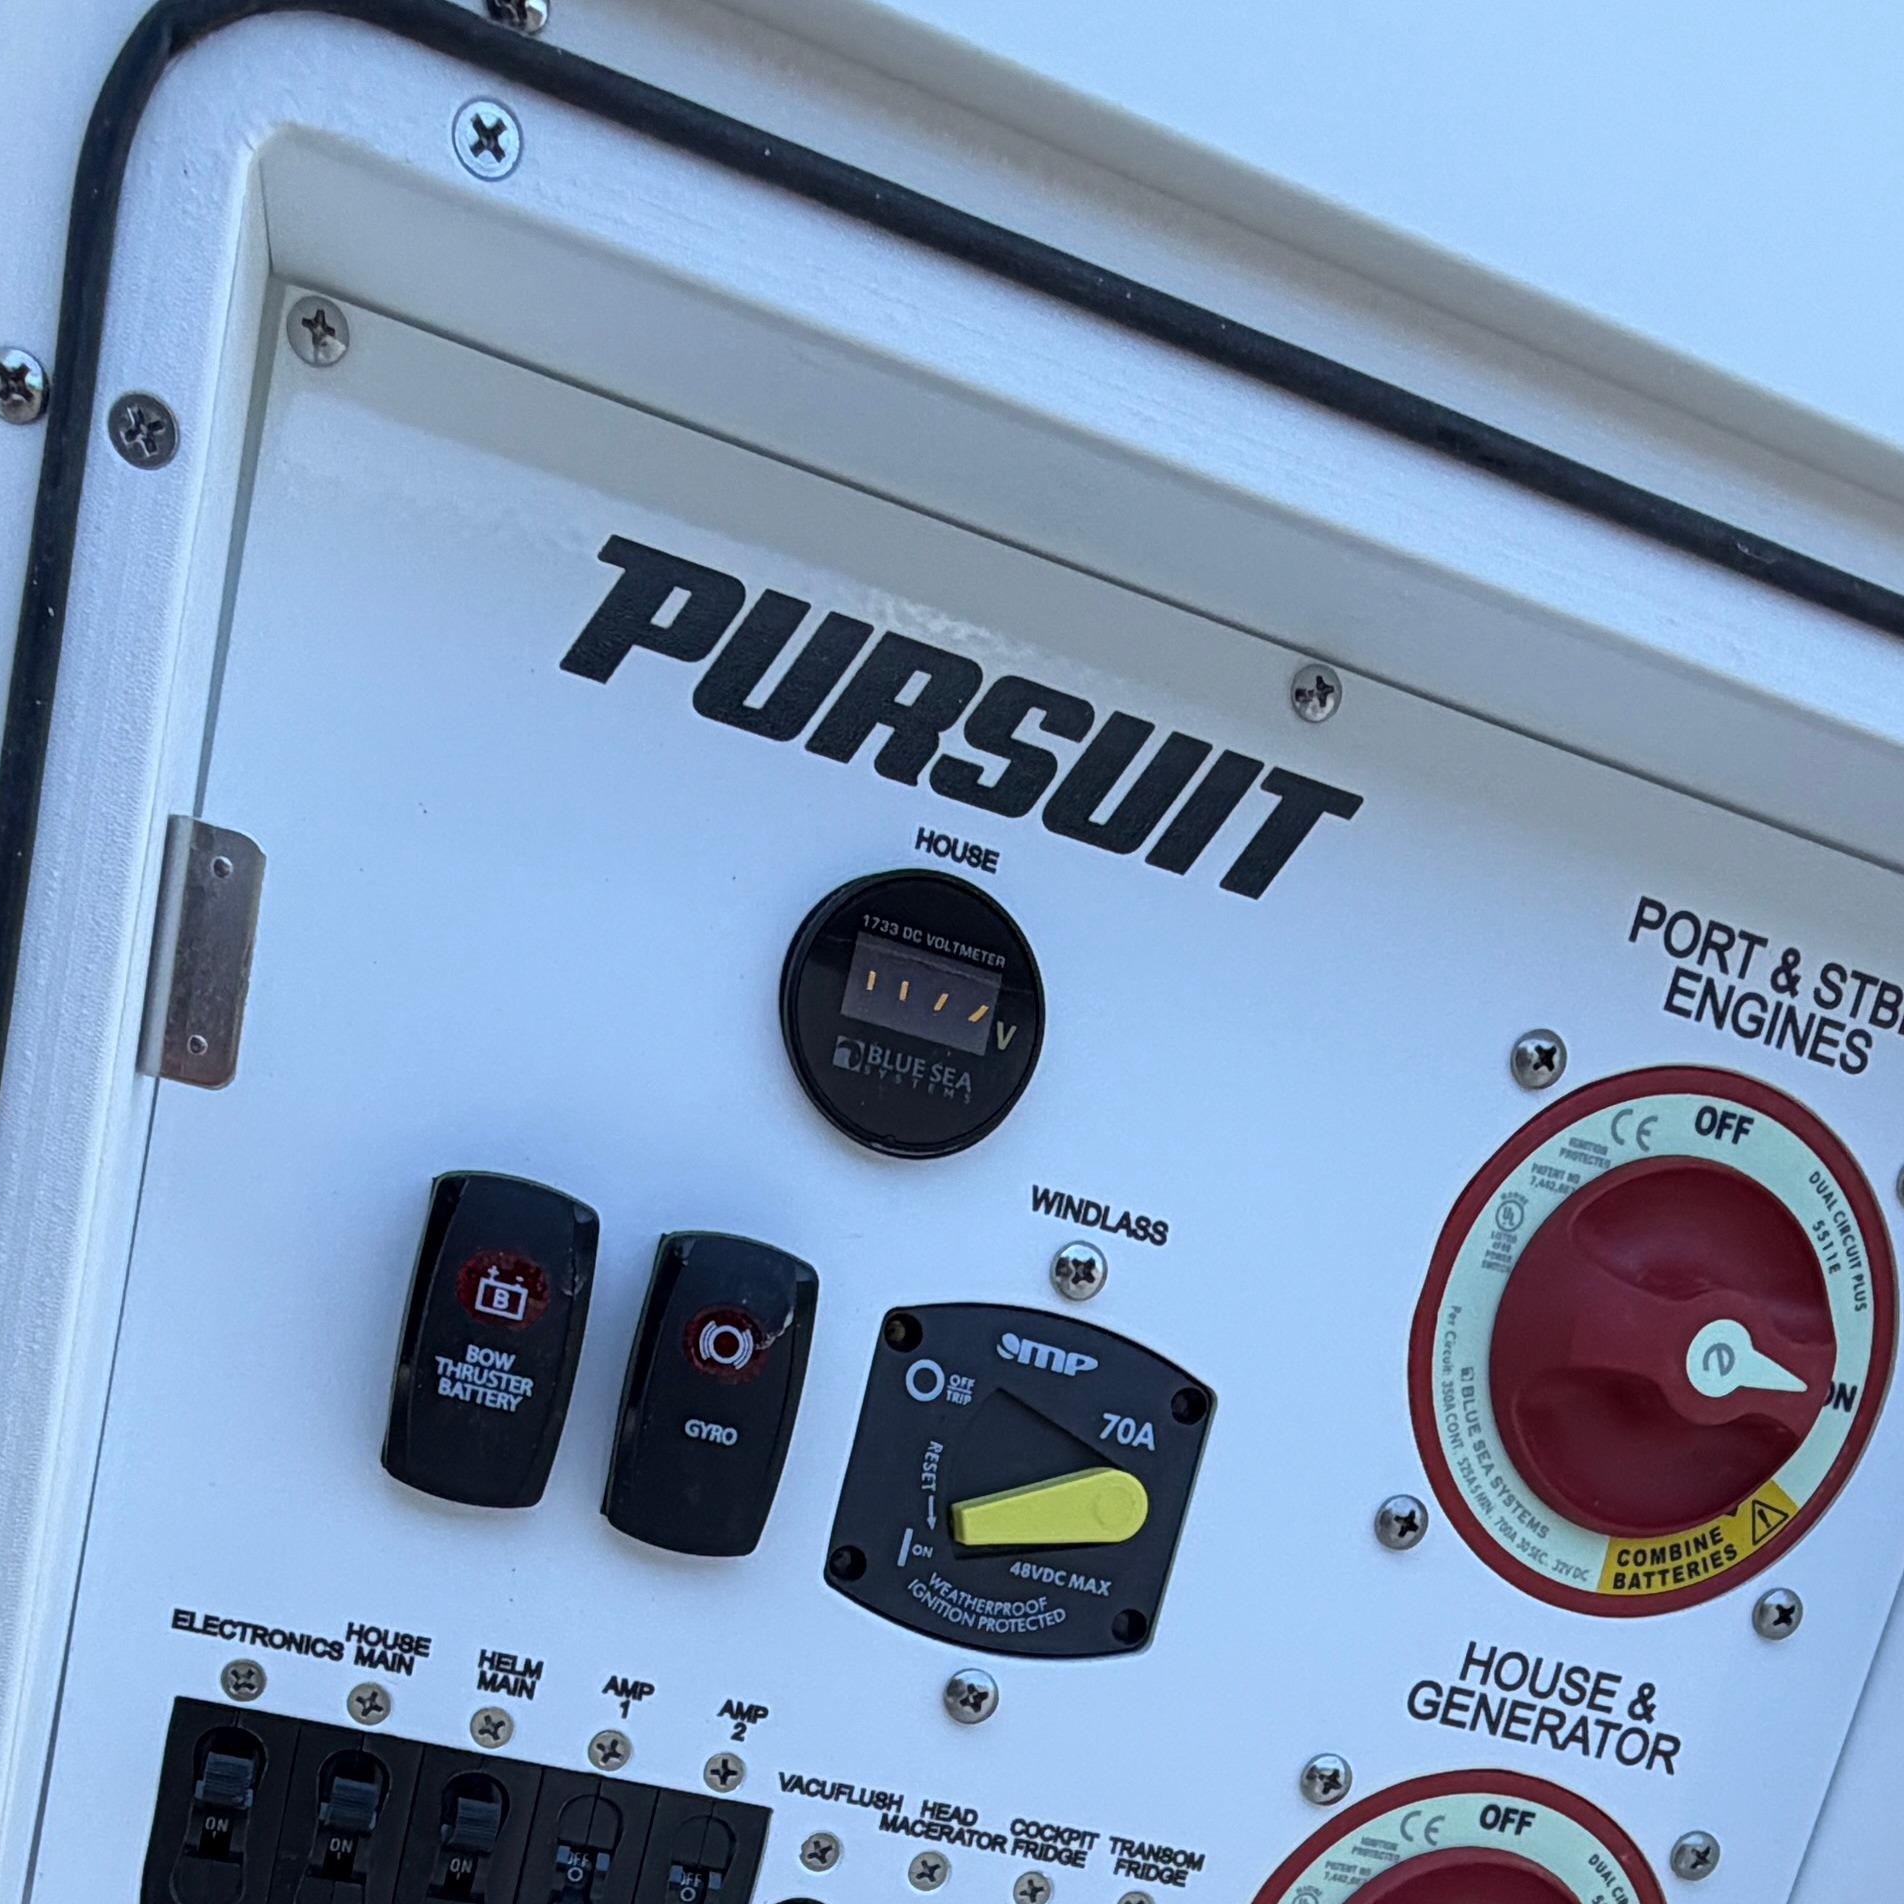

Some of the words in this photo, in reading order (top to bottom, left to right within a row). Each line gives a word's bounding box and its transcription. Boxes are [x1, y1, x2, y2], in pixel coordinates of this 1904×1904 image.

[559, 533, 1364, 900] PURSUIT
[915, 827, 1000, 874] HOUSE
[862, 914, 900, 935] 1733
[903, 926, 922, 943] DC
[926, 935, 1006, 968] VOLTMETER
[1628, 896, 1768, 980] PORT
[1770, 948, 1802, 997] &
[996, 1021, 1016, 1050] V
[1663, 967, 1874, 1074] ENGINES
[867, 1045, 926, 1078] BLUE
[930, 1063, 972, 1092] SEA
[1695, 1105, 1754, 1145] OFF
[1032, 1185, 1170, 1245] WINDLASS
[1809, 1171, 1834, 1212] DUAL
[1833, 1211, 1861, 1269] CIRCUIT
[1852, 1273, 1867, 1312] PLUS
[466, 1344, 517, 1370] BOW
[434, 1355, 533, 1397] THRUSTER
[949, 1373, 974, 1391] OFF
[438, 1379, 522, 1412] BATTERY
[947, 1392, 972, 1405] TRIP
[685, 1419, 738, 1446] GYRO
[1099, 1413, 1156, 1451] 70A
[921, 1441, 943, 1492] RESET
[912, 1544, 933, 1558] ON
[1616, 1526, 1724, 1567] COMBINE
[1010, 1561, 1068, 1587] 48VDC
[1069, 1573, 1112, 1596] MAX
[1613, 1544, 1738, 1589] BATTERIES
[908, 1580, 976, 1628] IGNITION
[976, 1608, 1067, 1633] PROTECTED
[928, 1572, 1048, 1617] WEATHERPROOF
[171, 1608, 345, 1662] ELECTRONICS
[346, 1622, 432, 1658] HOUSE
[354, 1645, 416, 1677] MAIN
[478, 1649, 544, 1680] HELM
[477, 1671, 537, 1700] MAIN
[604, 1675, 654, 1702] AMP
[1459, 1640, 1622, 1713] HOUSE
[1627, 1682, 1656, 1724] &
[620, 1701, 631, 1719] 1
[718, 1699, 769, 1725] AMP
[1407, 1680, 1681, 1776] GENERATOR
[732, 1723, 748, 1742] 2
[778, 1772, 904, 1812] VACUFLUSH
[920, 1800, 979, 1827] HEAD
[1479, 1804, 1536, 1835] OFF
[879, 1814, 1008, 1855] MACERATOR
[1010, 1819, 1100, 1851] COCKPIT
[1011, 1840, 1086, 1870] FRIDGE
[1109, 1836, 1205, 1872] TRANSOM
[1113, 1858, 1189, 1888] FRIDGE
